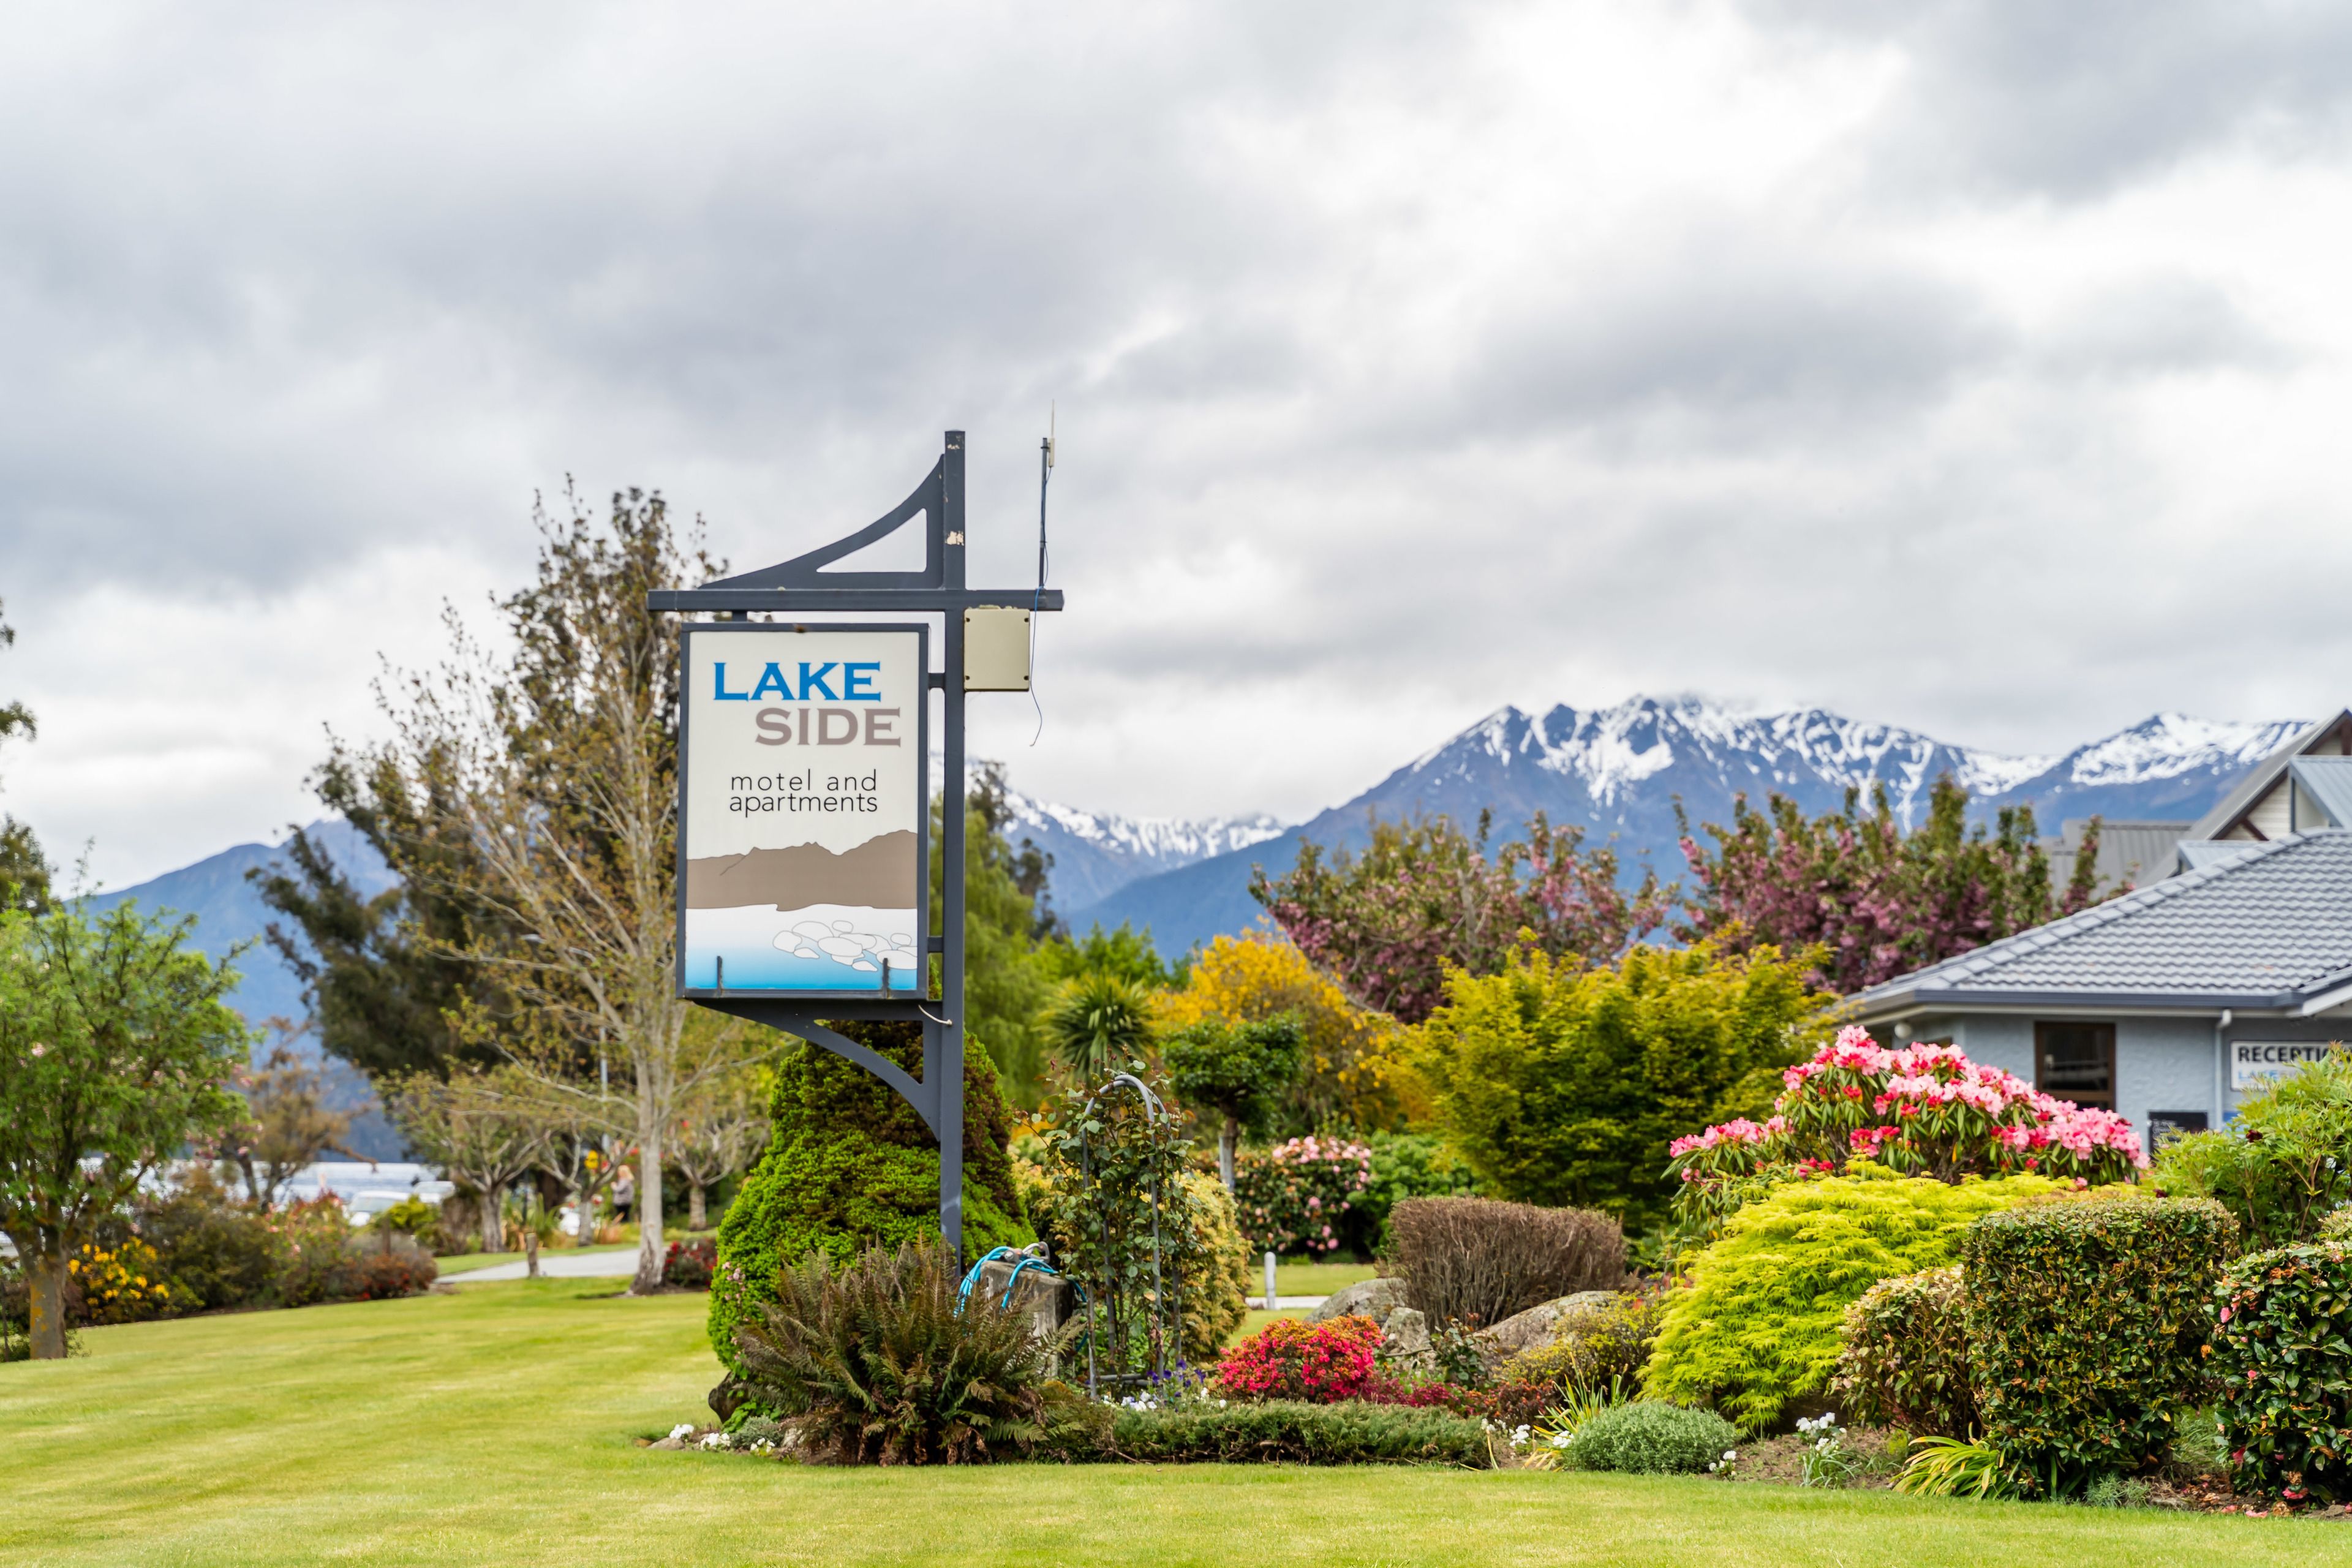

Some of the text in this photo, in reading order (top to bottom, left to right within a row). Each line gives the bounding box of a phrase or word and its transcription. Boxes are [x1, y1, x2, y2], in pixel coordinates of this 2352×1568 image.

[713, 661, 881, 702] LAKE
[755, 707, 901, 747] SIDE
[731, 768, 877, 791] motel and
[729, 793, 878, 818] apartments
[2238, 1045, 2352, 1063] RECEPTI
